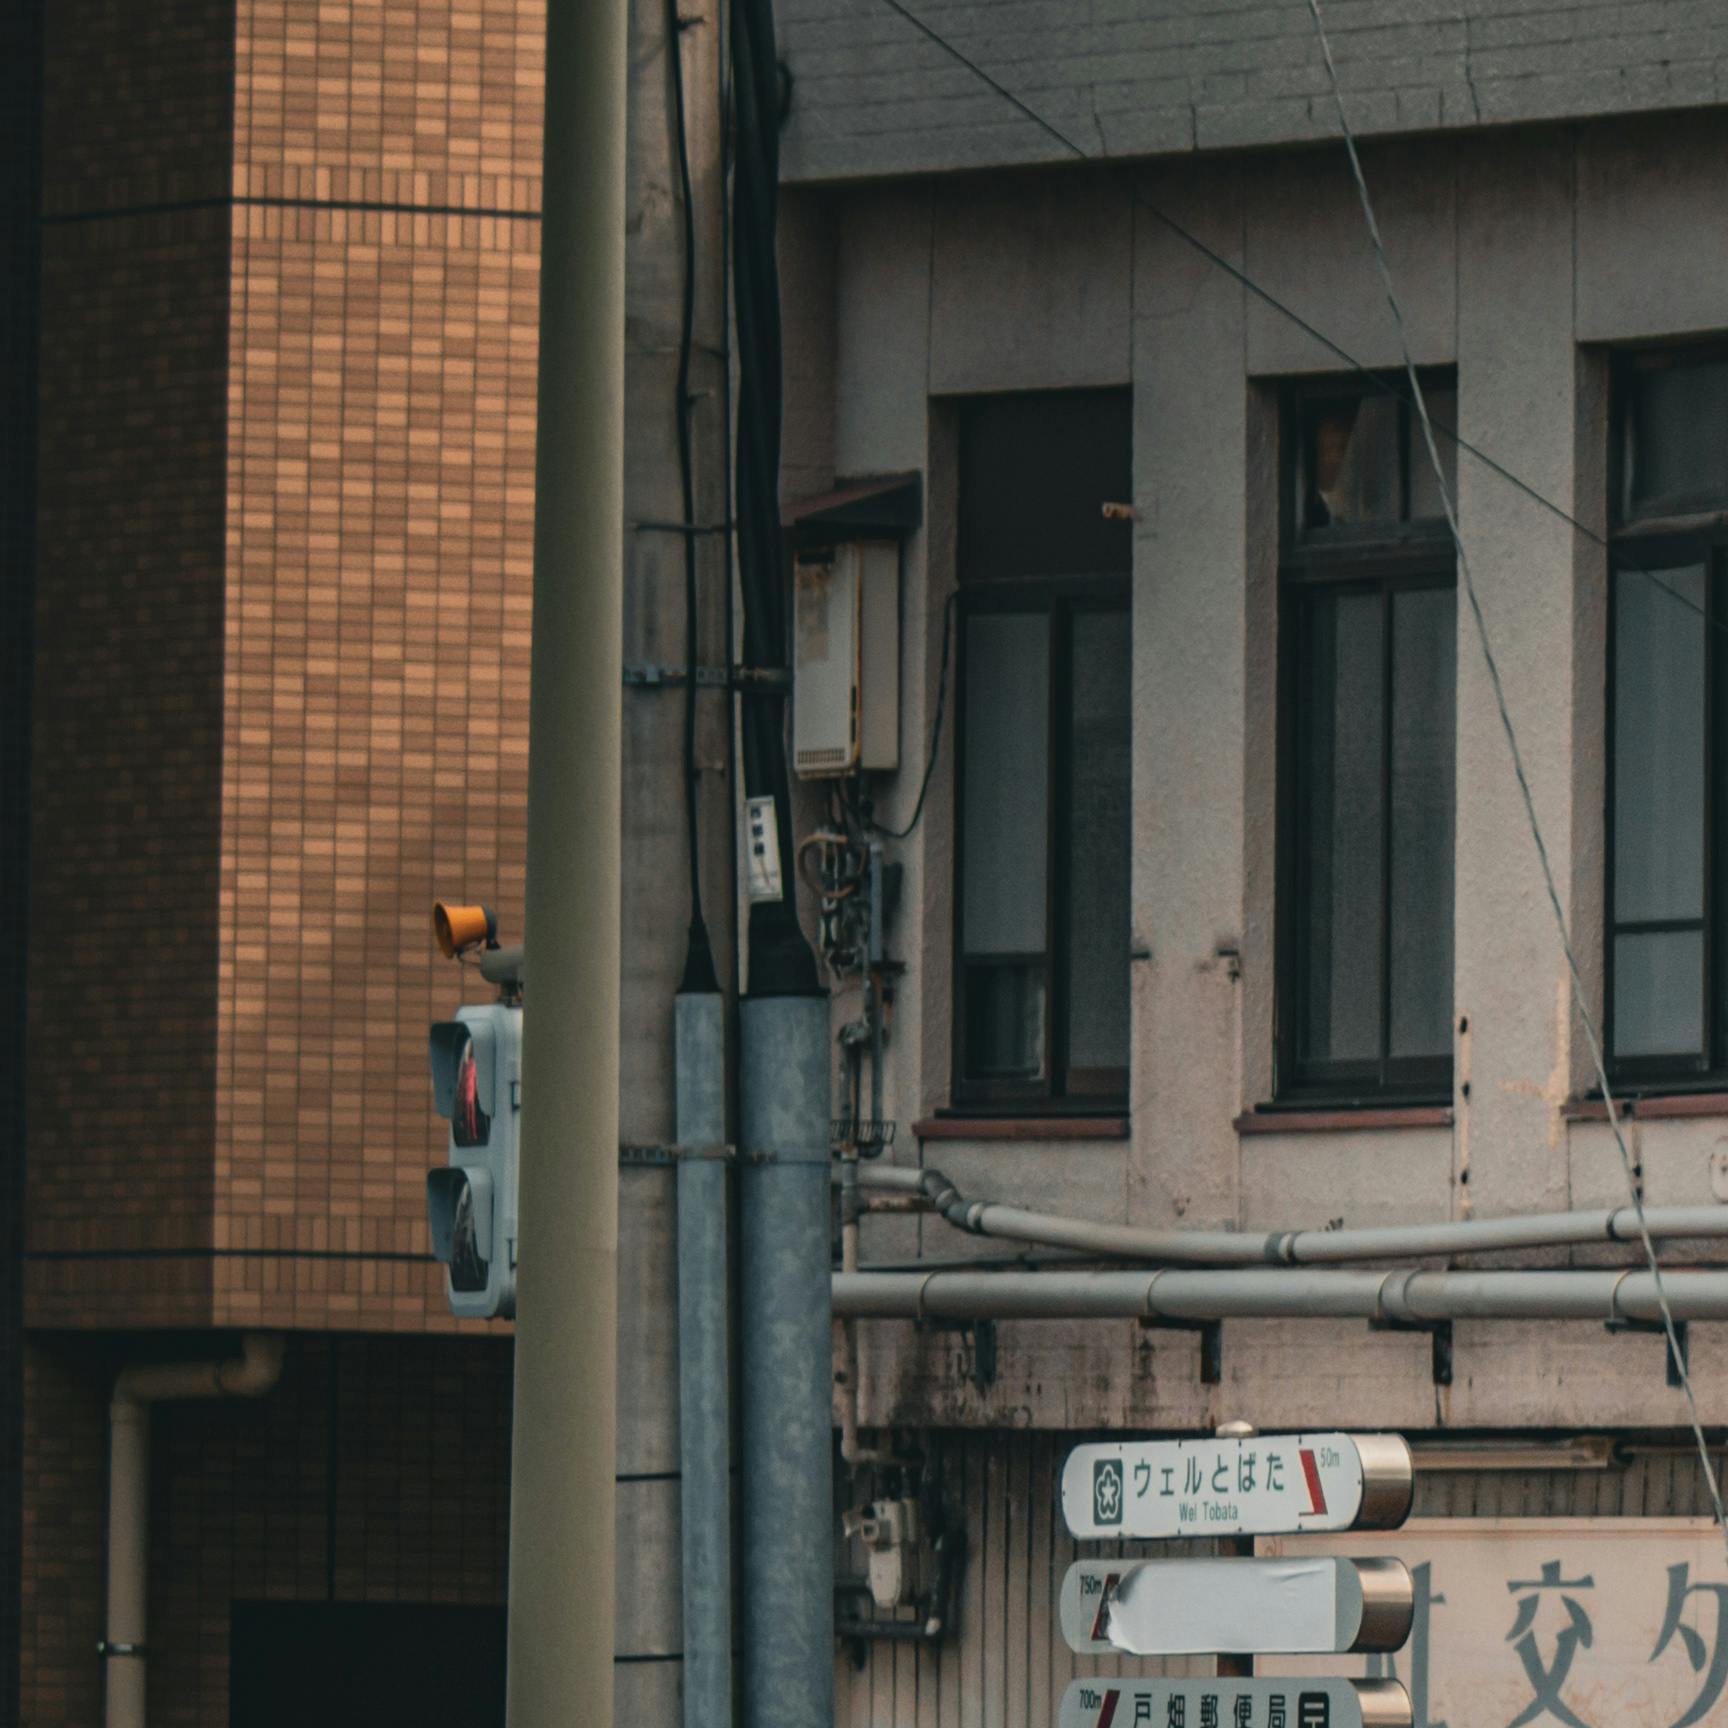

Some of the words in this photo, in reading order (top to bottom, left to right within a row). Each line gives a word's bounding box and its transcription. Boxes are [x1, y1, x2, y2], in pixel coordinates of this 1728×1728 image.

[1320, 1448, 1340, 1468] 50m
[1133, 1452, 1285, 1499] ウェルとばた
[1202, 1501, 1239, 1521] Tobata
